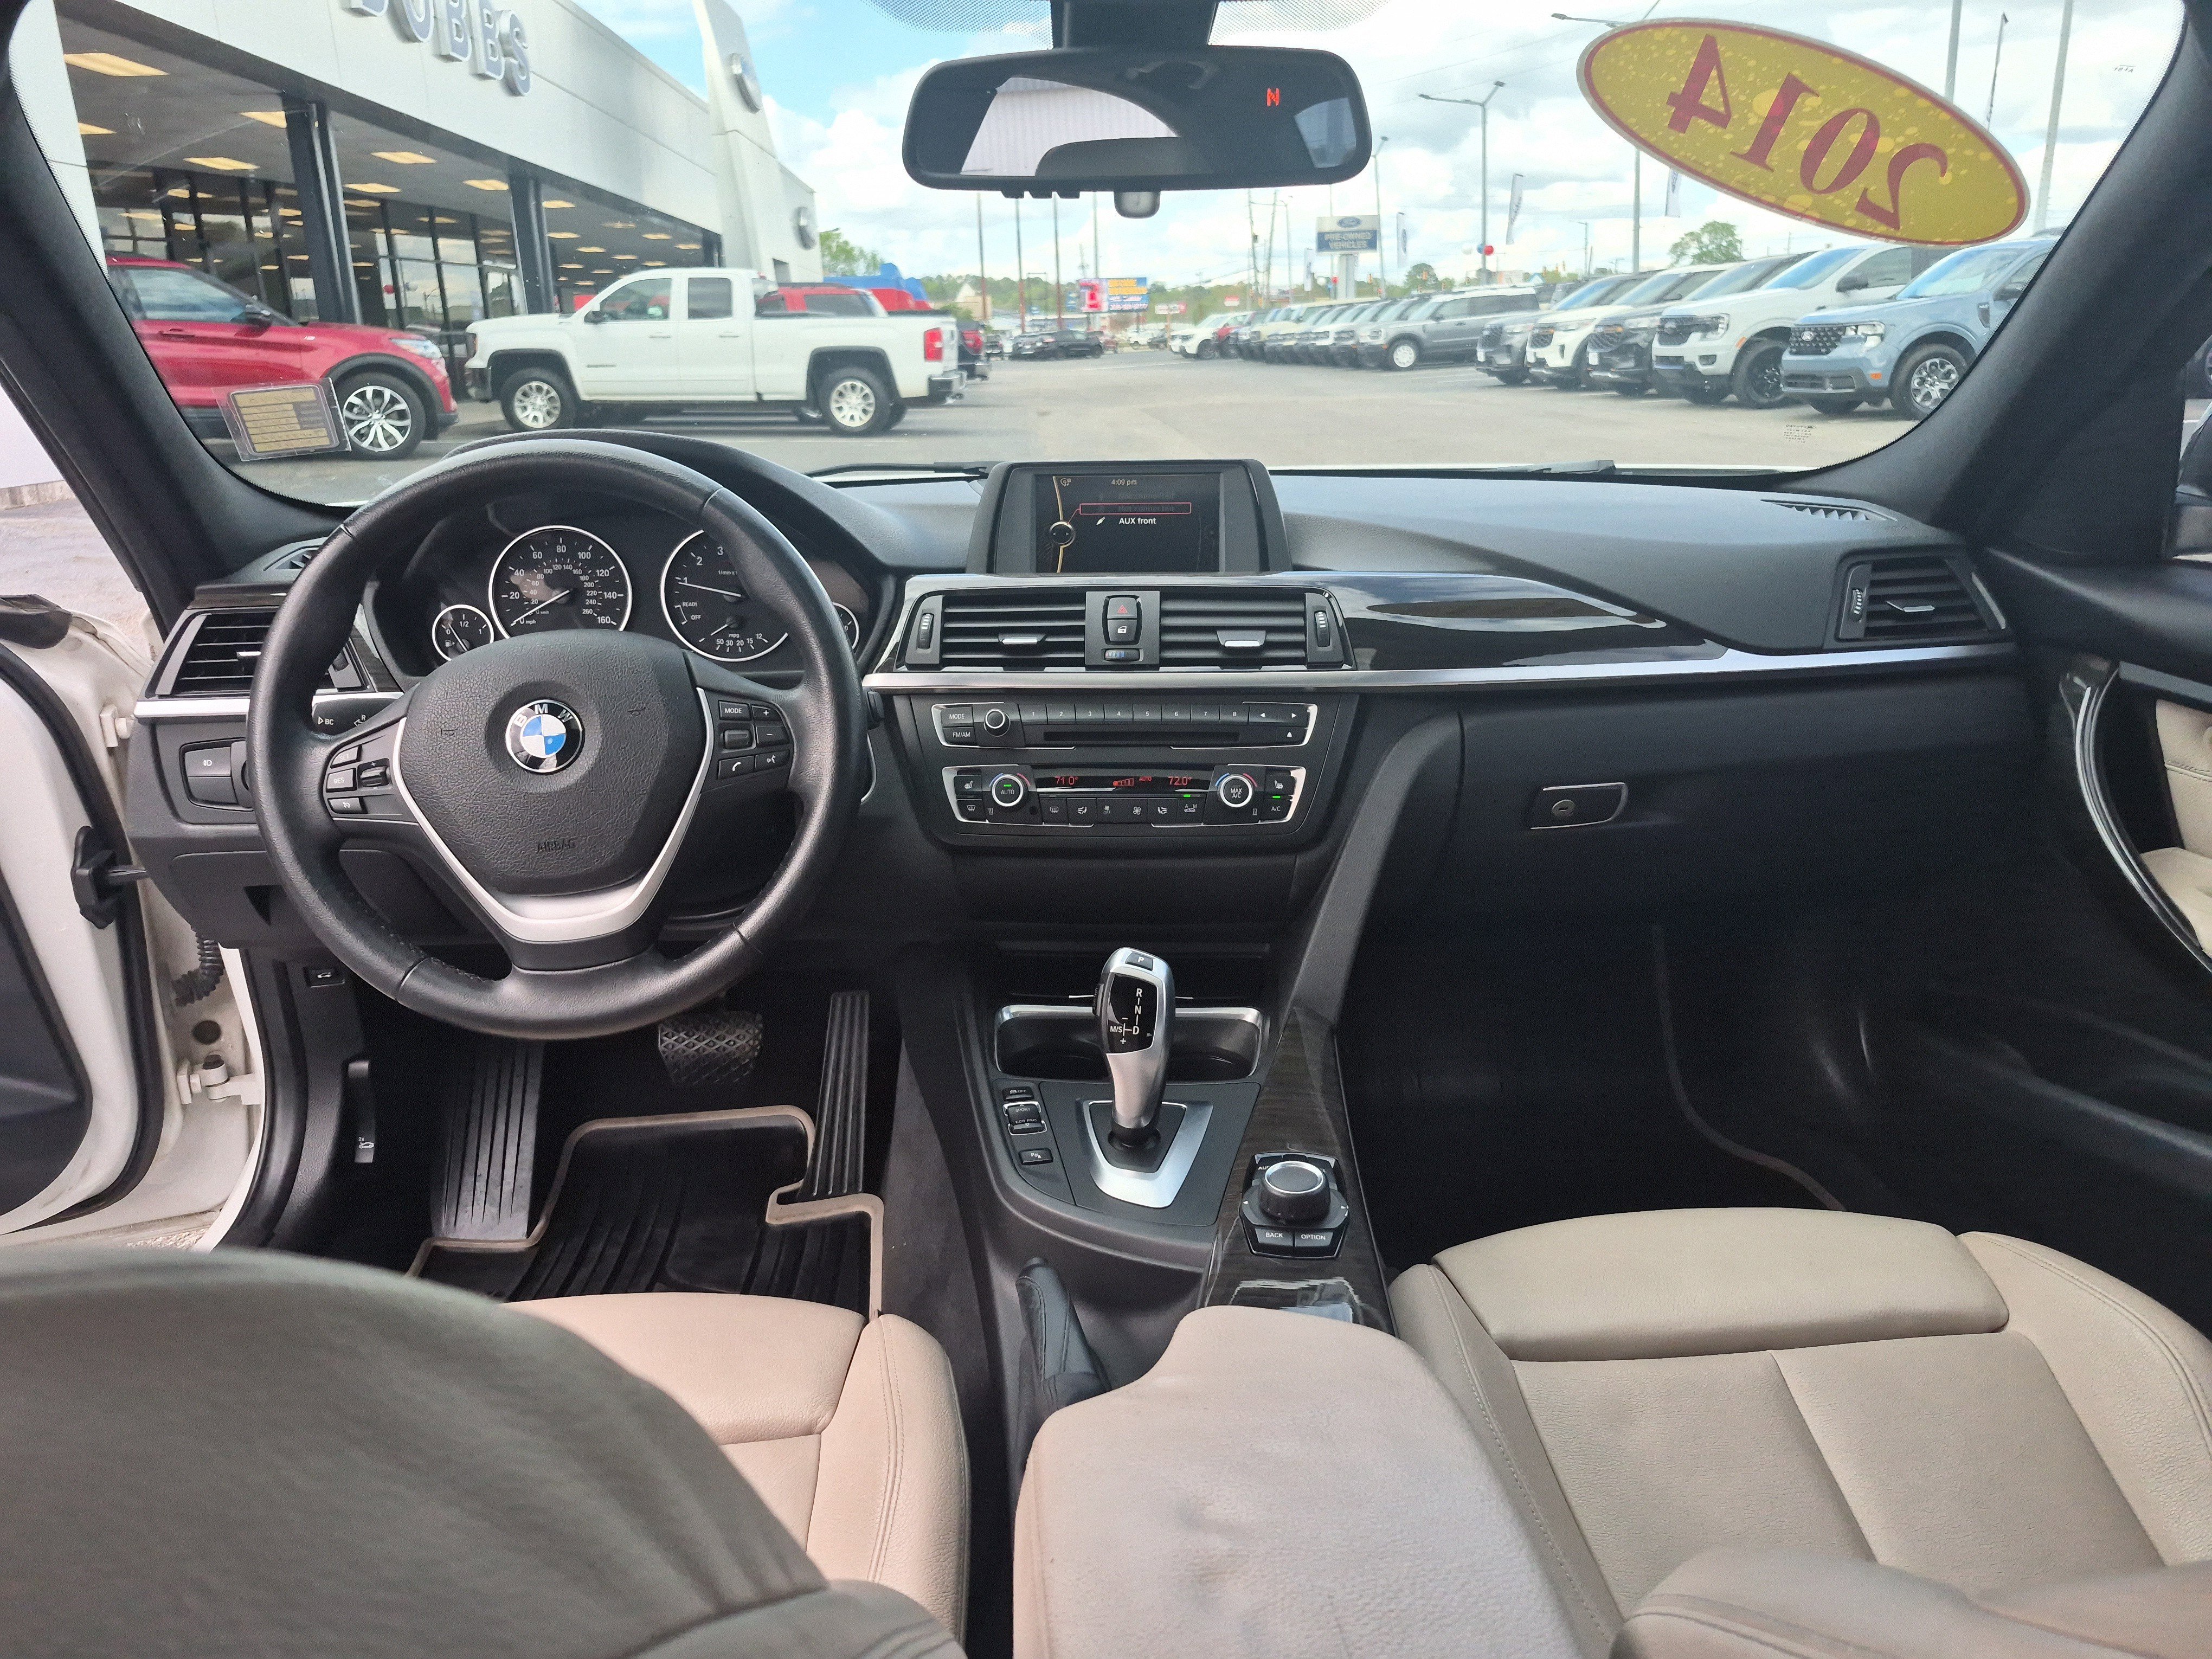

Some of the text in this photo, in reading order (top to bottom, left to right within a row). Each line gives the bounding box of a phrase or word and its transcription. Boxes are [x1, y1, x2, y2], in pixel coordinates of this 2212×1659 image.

[348, 0, 531, 96] OBBS
[1266, 88, 1280, 106] N
[1324, 232, 1373, 241] PRE-OWNED
[1329, 240, 1368, 249] VEHICLES
[556, 545, 567, 553] 80
[717, 546, 723, 556] 3
[577, 551, 591, 560] 100
[696, 556, 703, 565] 2
[596, 569, 609, 577] 120
[513, 703, 574, 728] BMW
[1136, 988, 1142, 998] R
[1134, 1005, 1141, 1015] N
[1133, 1026, 1140, 1035] D
